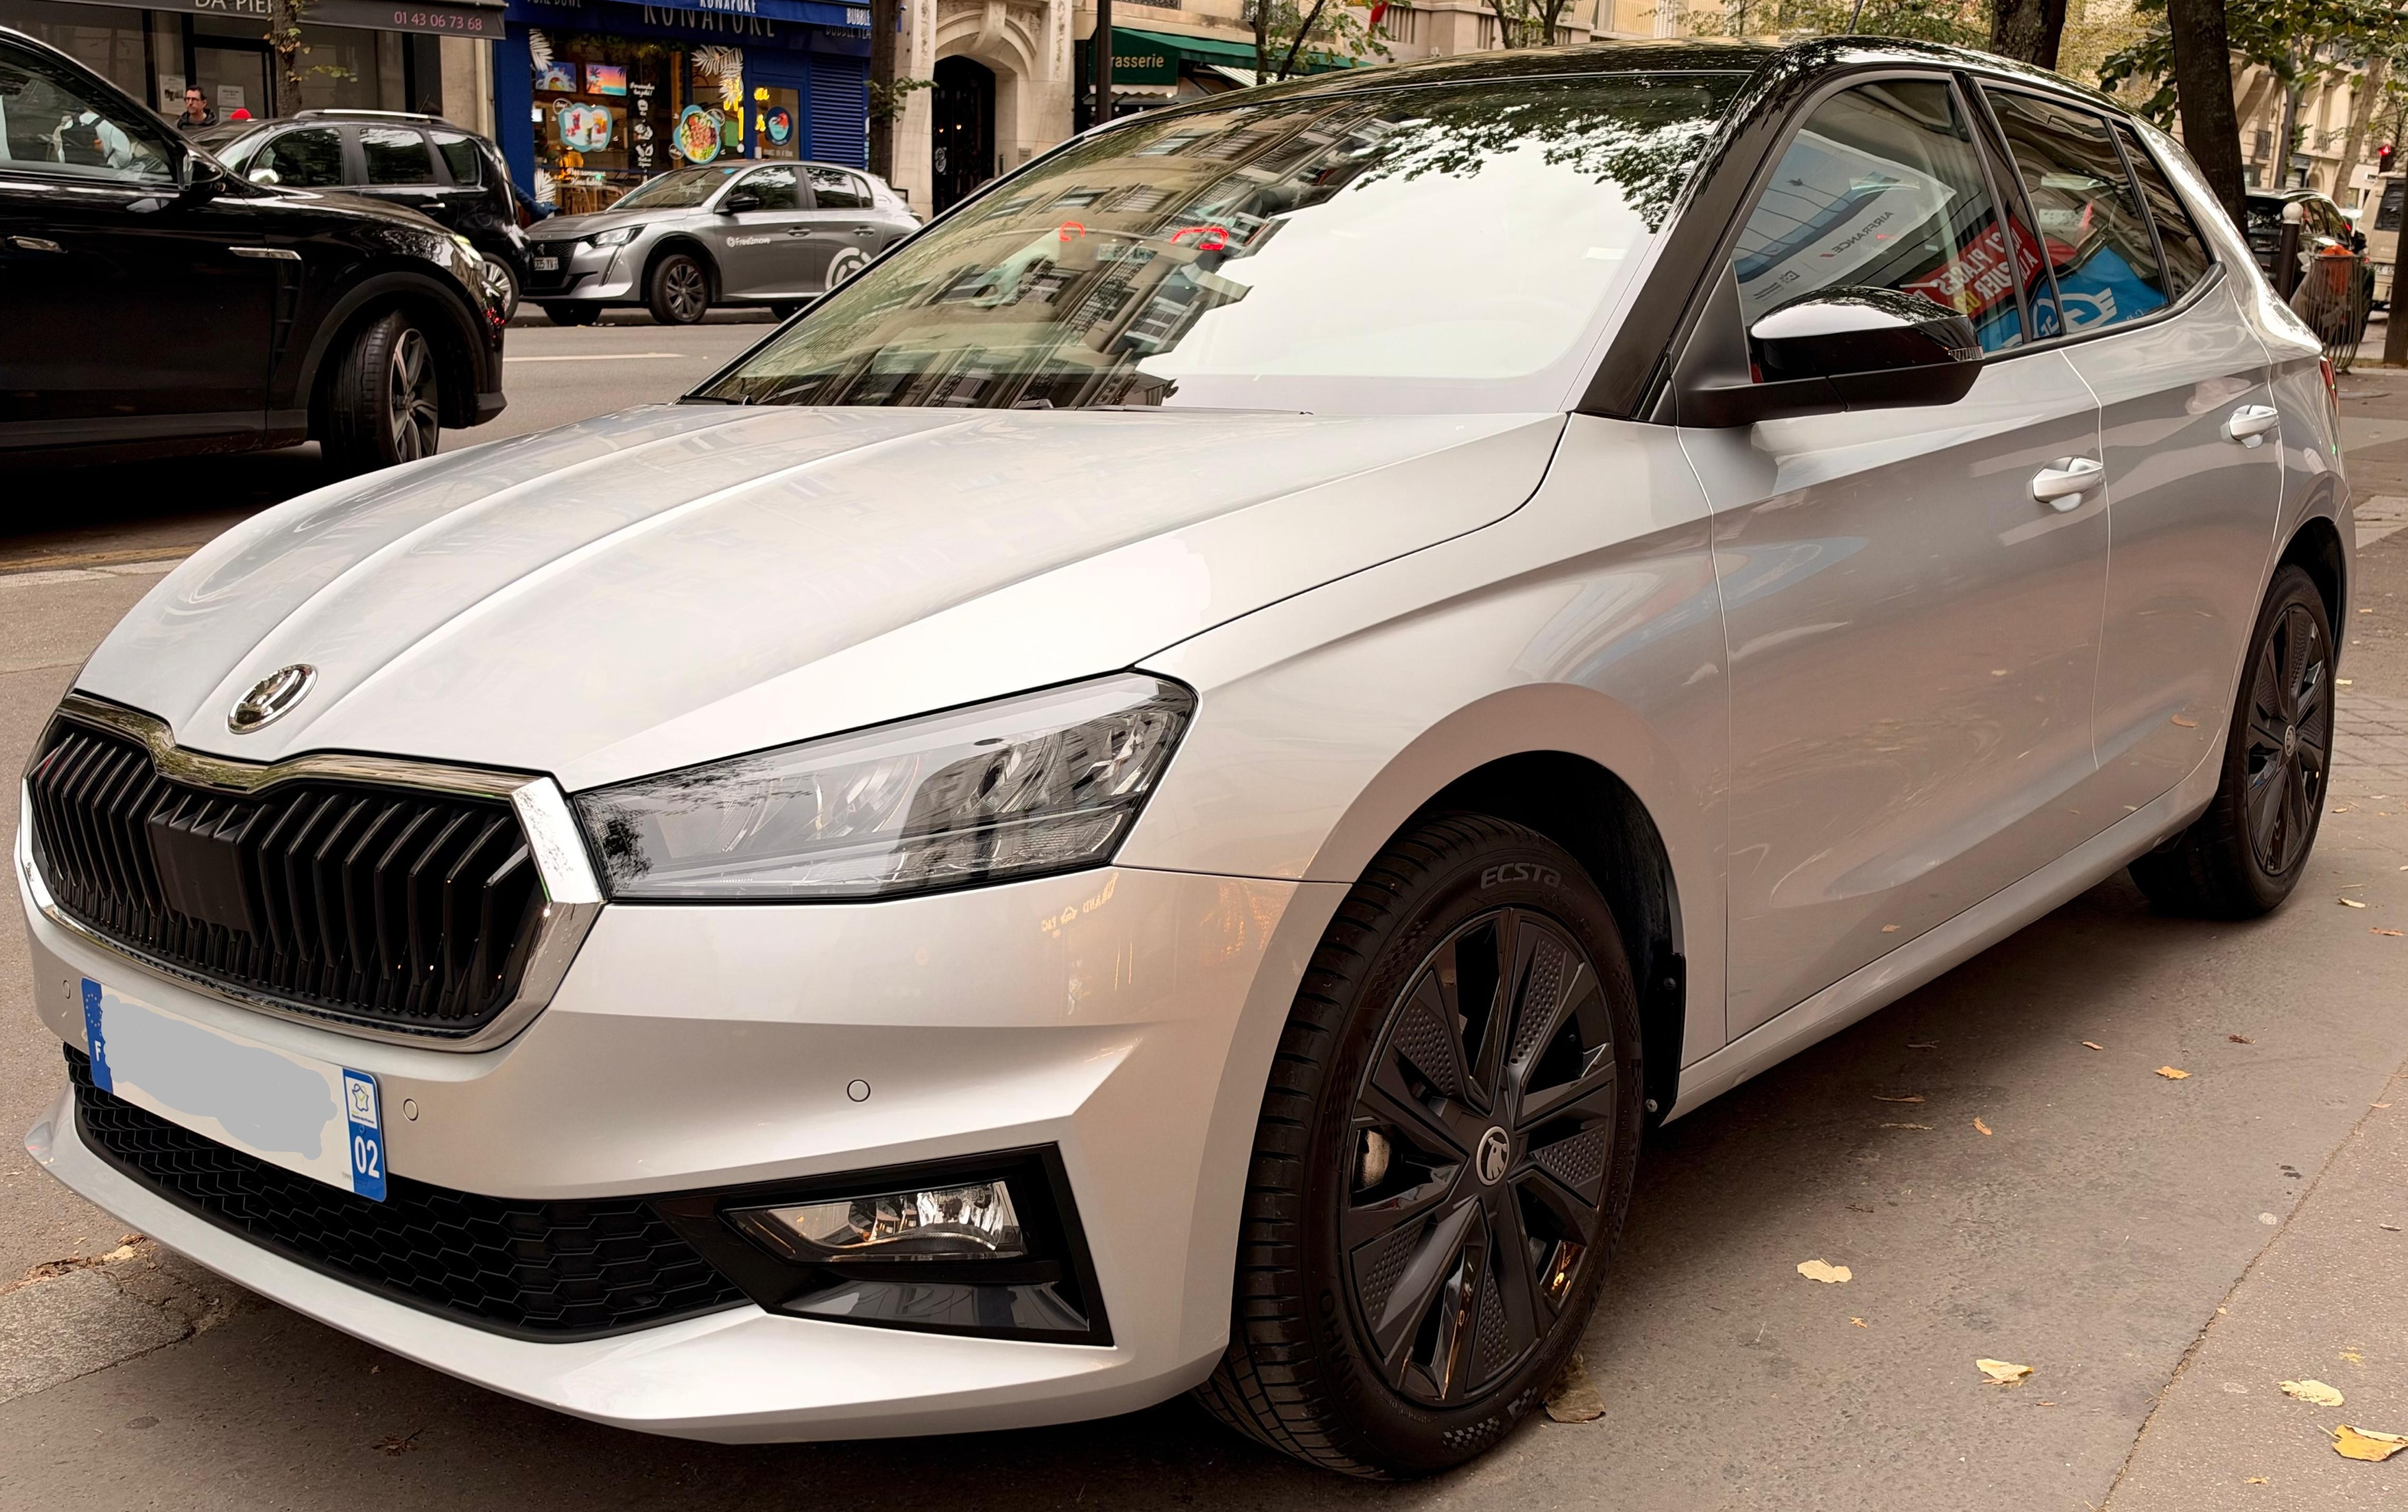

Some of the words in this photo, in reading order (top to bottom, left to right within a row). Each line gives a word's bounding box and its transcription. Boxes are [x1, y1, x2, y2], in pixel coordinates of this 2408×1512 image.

[394, 11, 407, 24] 01
[411, 13, 426, 26] 43
[430, 14, 446, 27] 06
[449, 16, 464, 29] 73
[467, 18, 483, 30] 68
[846, 7, 871, 26] BUBBLE
[1110, 54, 1164, 68] rasserie
[95, 1040, 101, 1061] F
[355, 1136, 380, 1179] 02
